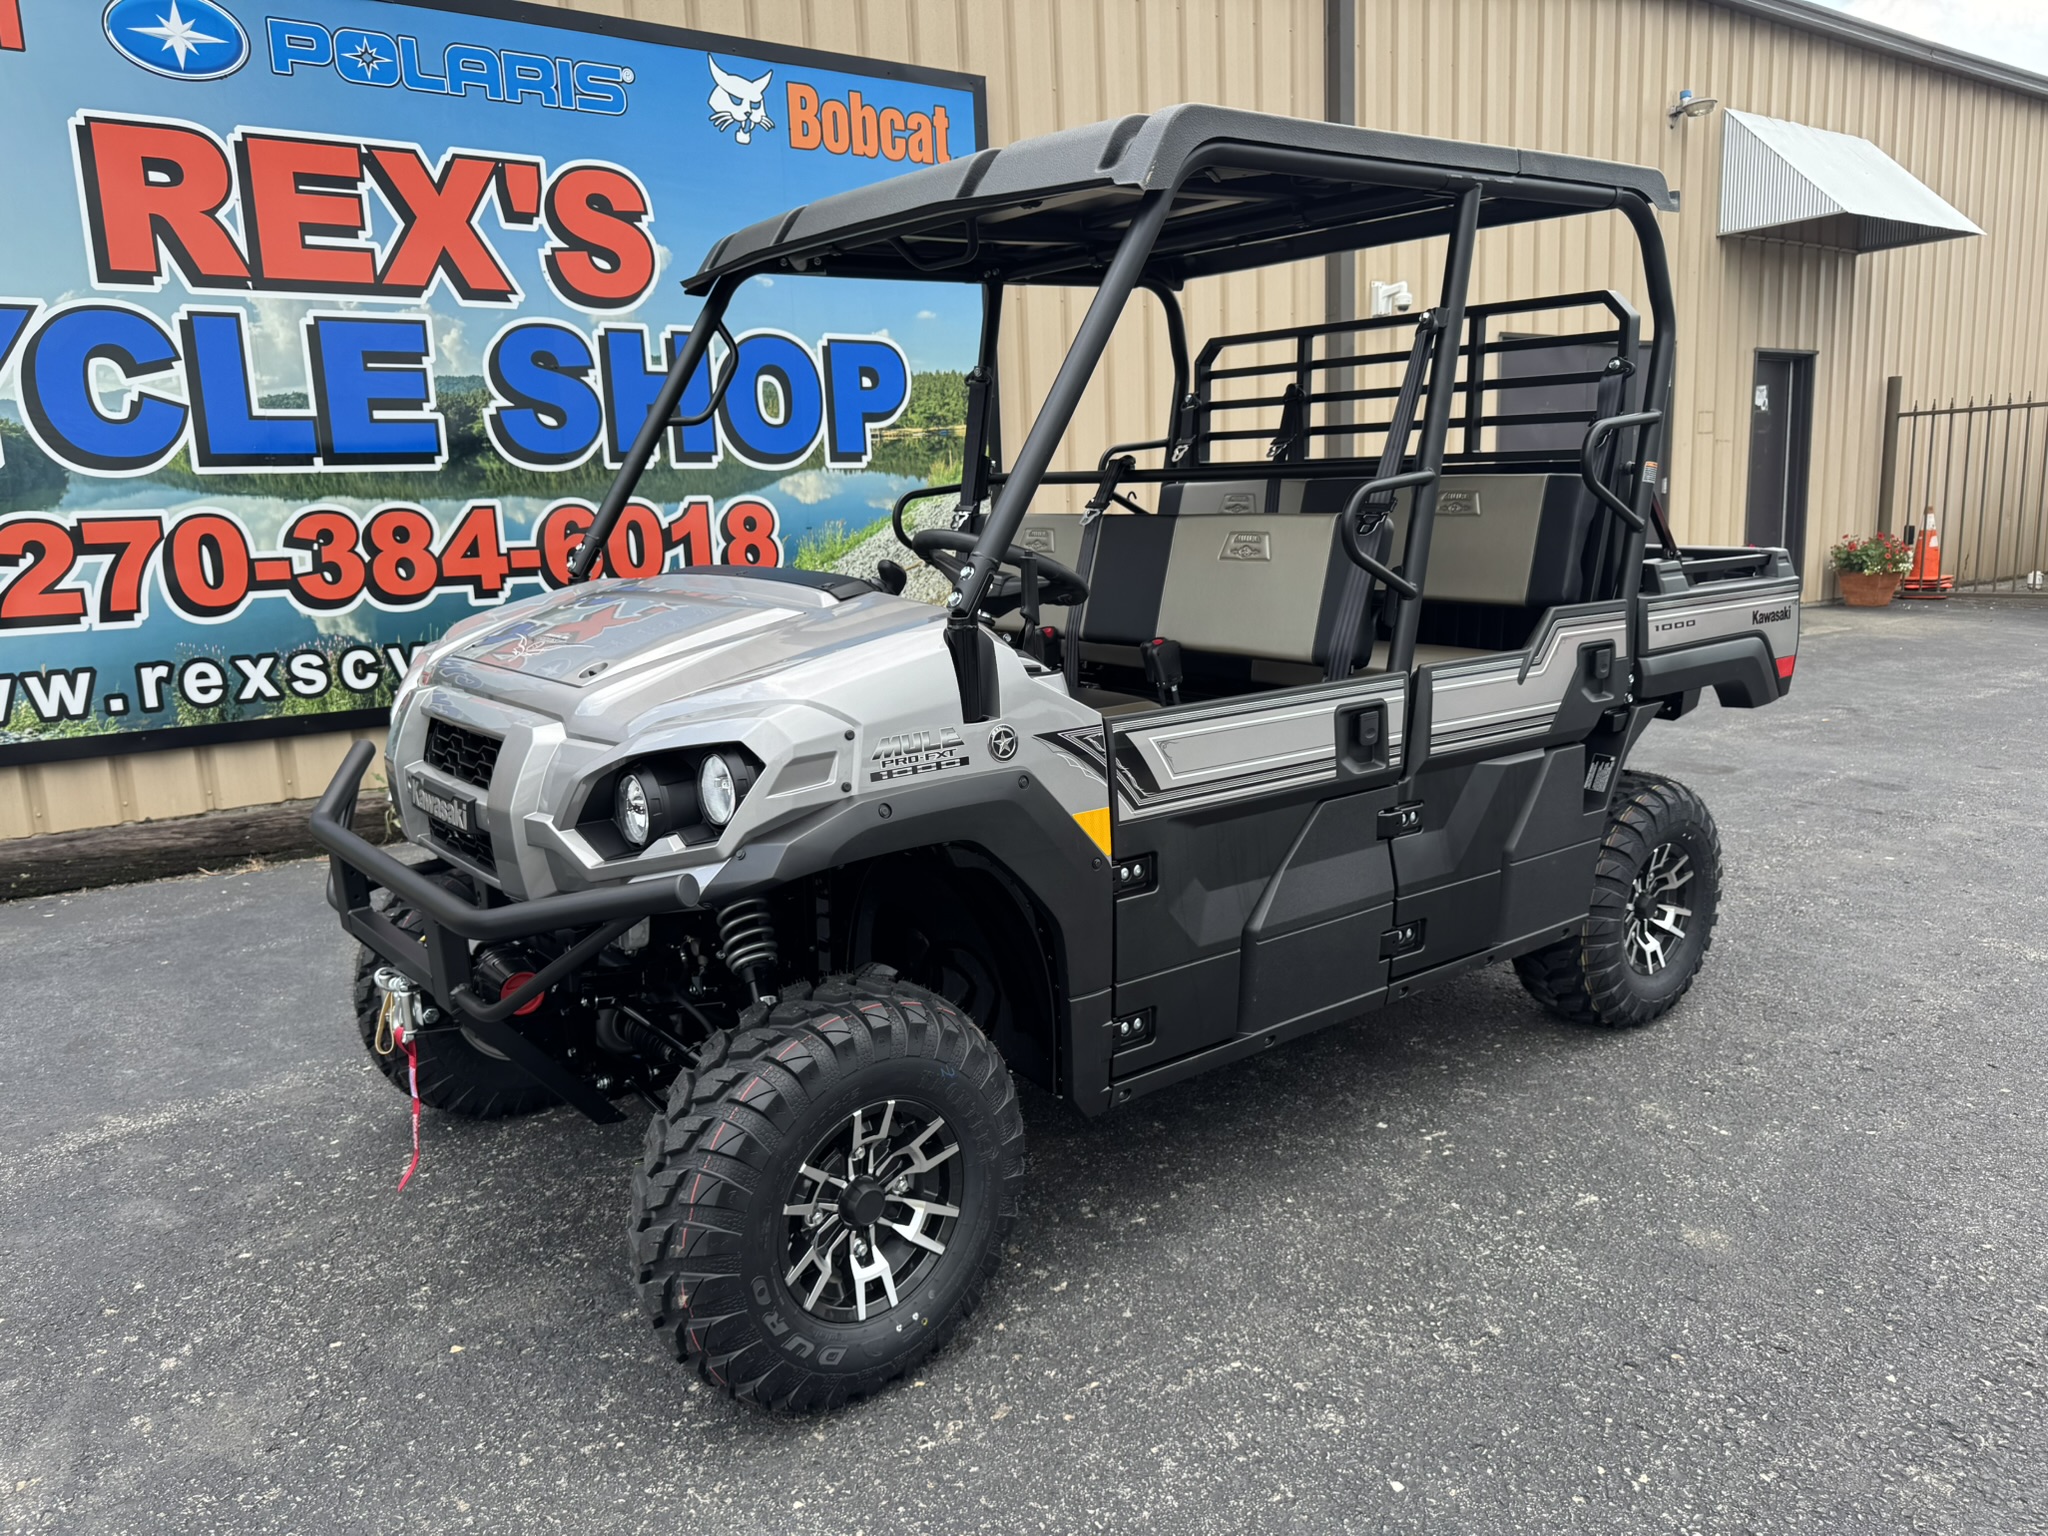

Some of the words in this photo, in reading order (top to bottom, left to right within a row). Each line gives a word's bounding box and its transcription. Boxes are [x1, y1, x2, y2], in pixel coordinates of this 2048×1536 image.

[786, 82, 951, 164] Bobcat
[76, 115, 656, 307] REX'S
[487, 321, 908, 466] SHOP
[0, 500, 780, 628] 270-384-6018
[1655, 619, 1696, 632] 1000
[1752, 605, 1791, 625] Kawasaki
[871, 726, 965, 760] MULE
[879, 757, 961, 780] 1000
[881, 749, 957, 769] PRO-FXT
[411, 777, 468, 831] Kawasaki
[751, 1275, 849, 1366] DURO
